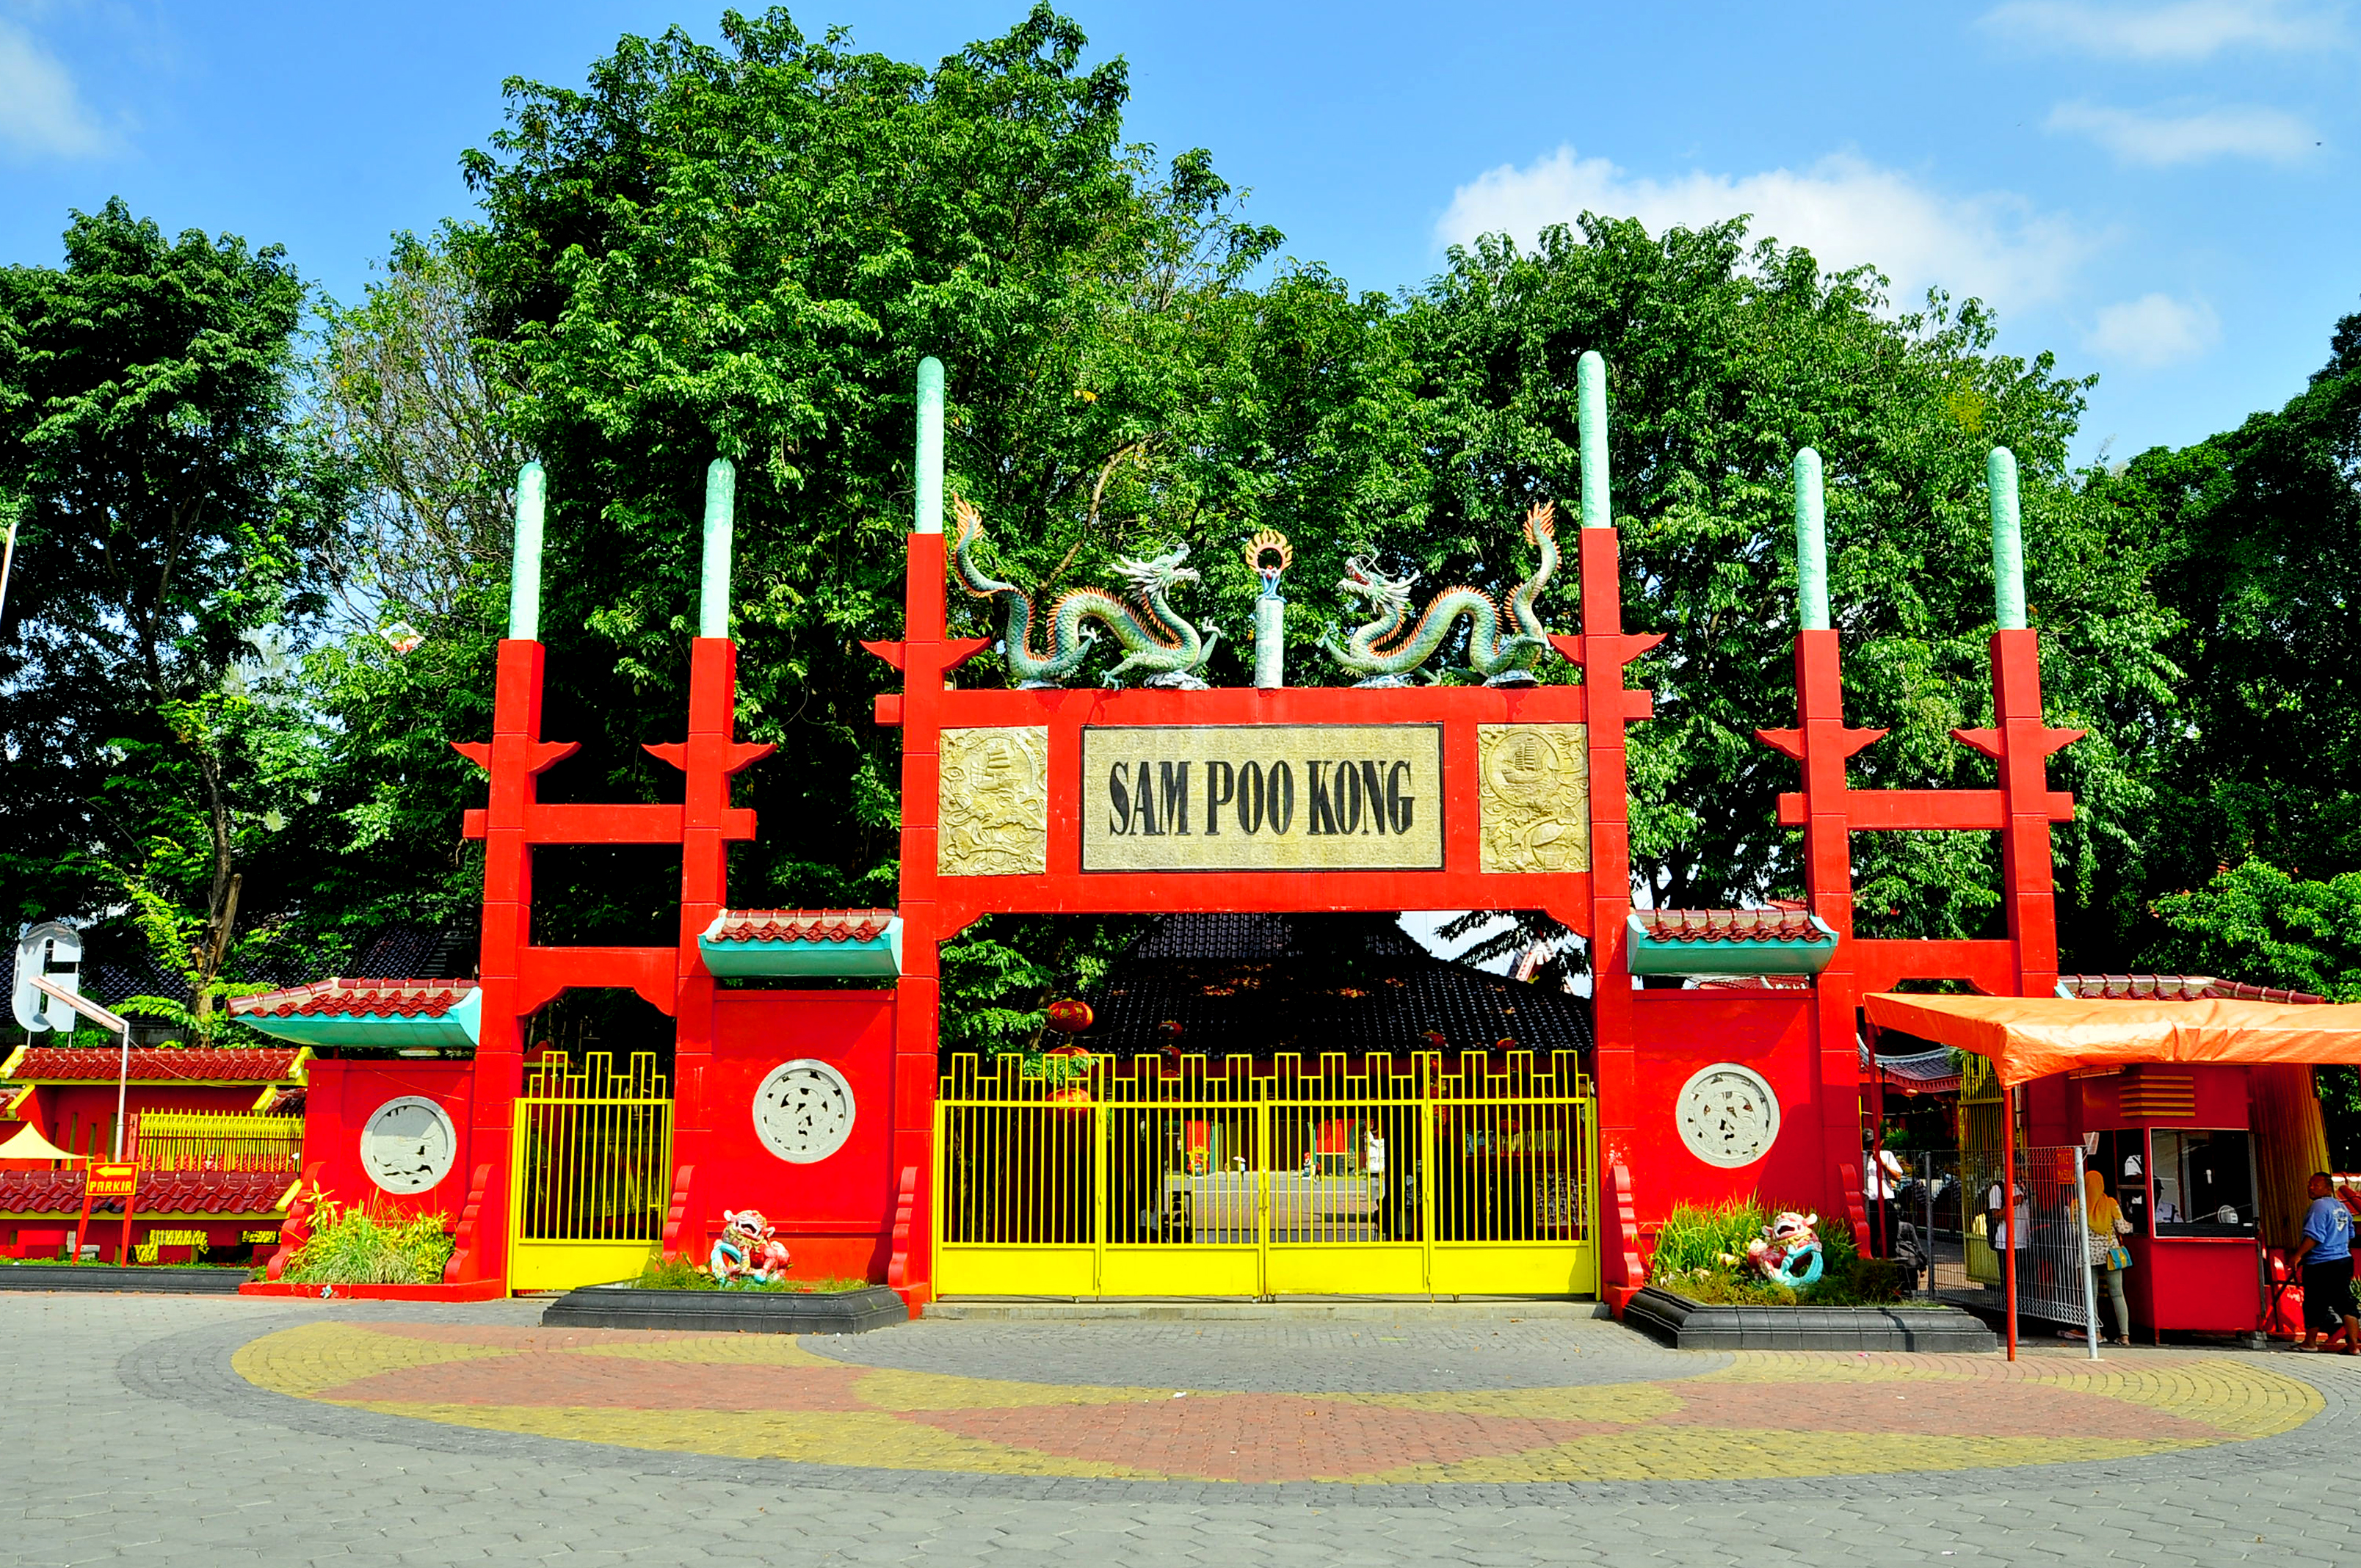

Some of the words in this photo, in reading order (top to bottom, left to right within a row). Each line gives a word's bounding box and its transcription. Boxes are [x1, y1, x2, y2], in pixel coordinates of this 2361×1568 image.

[1109, 761, 1192, 836] SAM
[1205, 761, 1294, 835] POO
[1306, 761, 1415, 835] KONG
[90, 1181, 132, 1192] PARKIR
